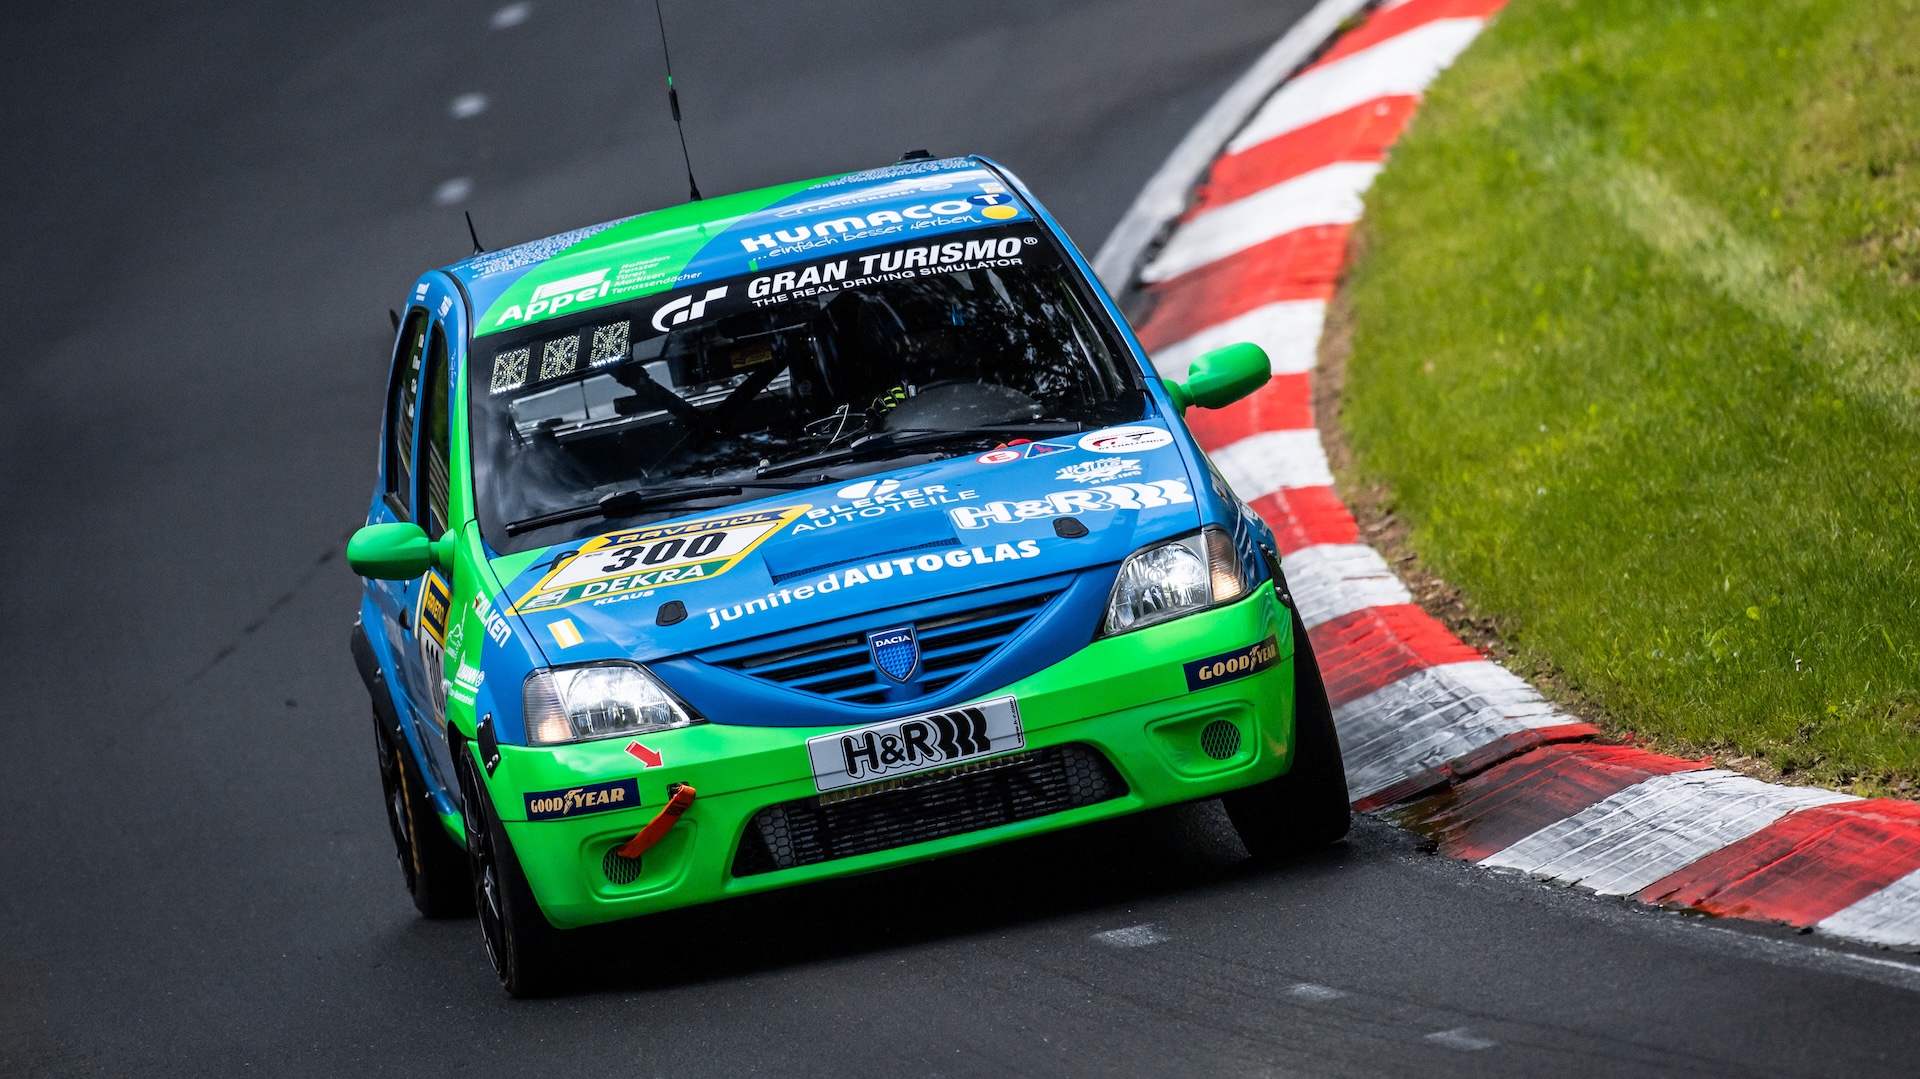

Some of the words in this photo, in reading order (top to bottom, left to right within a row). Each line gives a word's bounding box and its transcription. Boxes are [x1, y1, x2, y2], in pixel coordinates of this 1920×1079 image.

[843, 224, 903, 242] besser
[909, 213, 982, 231] werben
[611, 272, 702, 294] Terrassendächer
[613, 272, 665, 287] Markisen
[618, 262, 660, 275] Fenster
[748, 260, 848, 299] GRAN
[752, 294, 789, 308] THE
[791, 284, 840, 300] REAL
[842, 269, 916, 290] DRIVING
[920, 257, 1023, 277] SIMULATOR
[495, 280, 611, 326] Appel
[791, 489, 980, 536] AUTOTEILE
[807, 484, 949, 520] BLEKER
[950, 488, 1115, 530] H&R
[617, 512, 772, 543] RAVENOL
[602, 531, 728, 573] 300
[579, 564, 706, 598] DEKRA
[593, 590, 654, 606] KLAUS
[875, 634, 911, 648] DACIA
[840, 718, 942, 779] H&R
